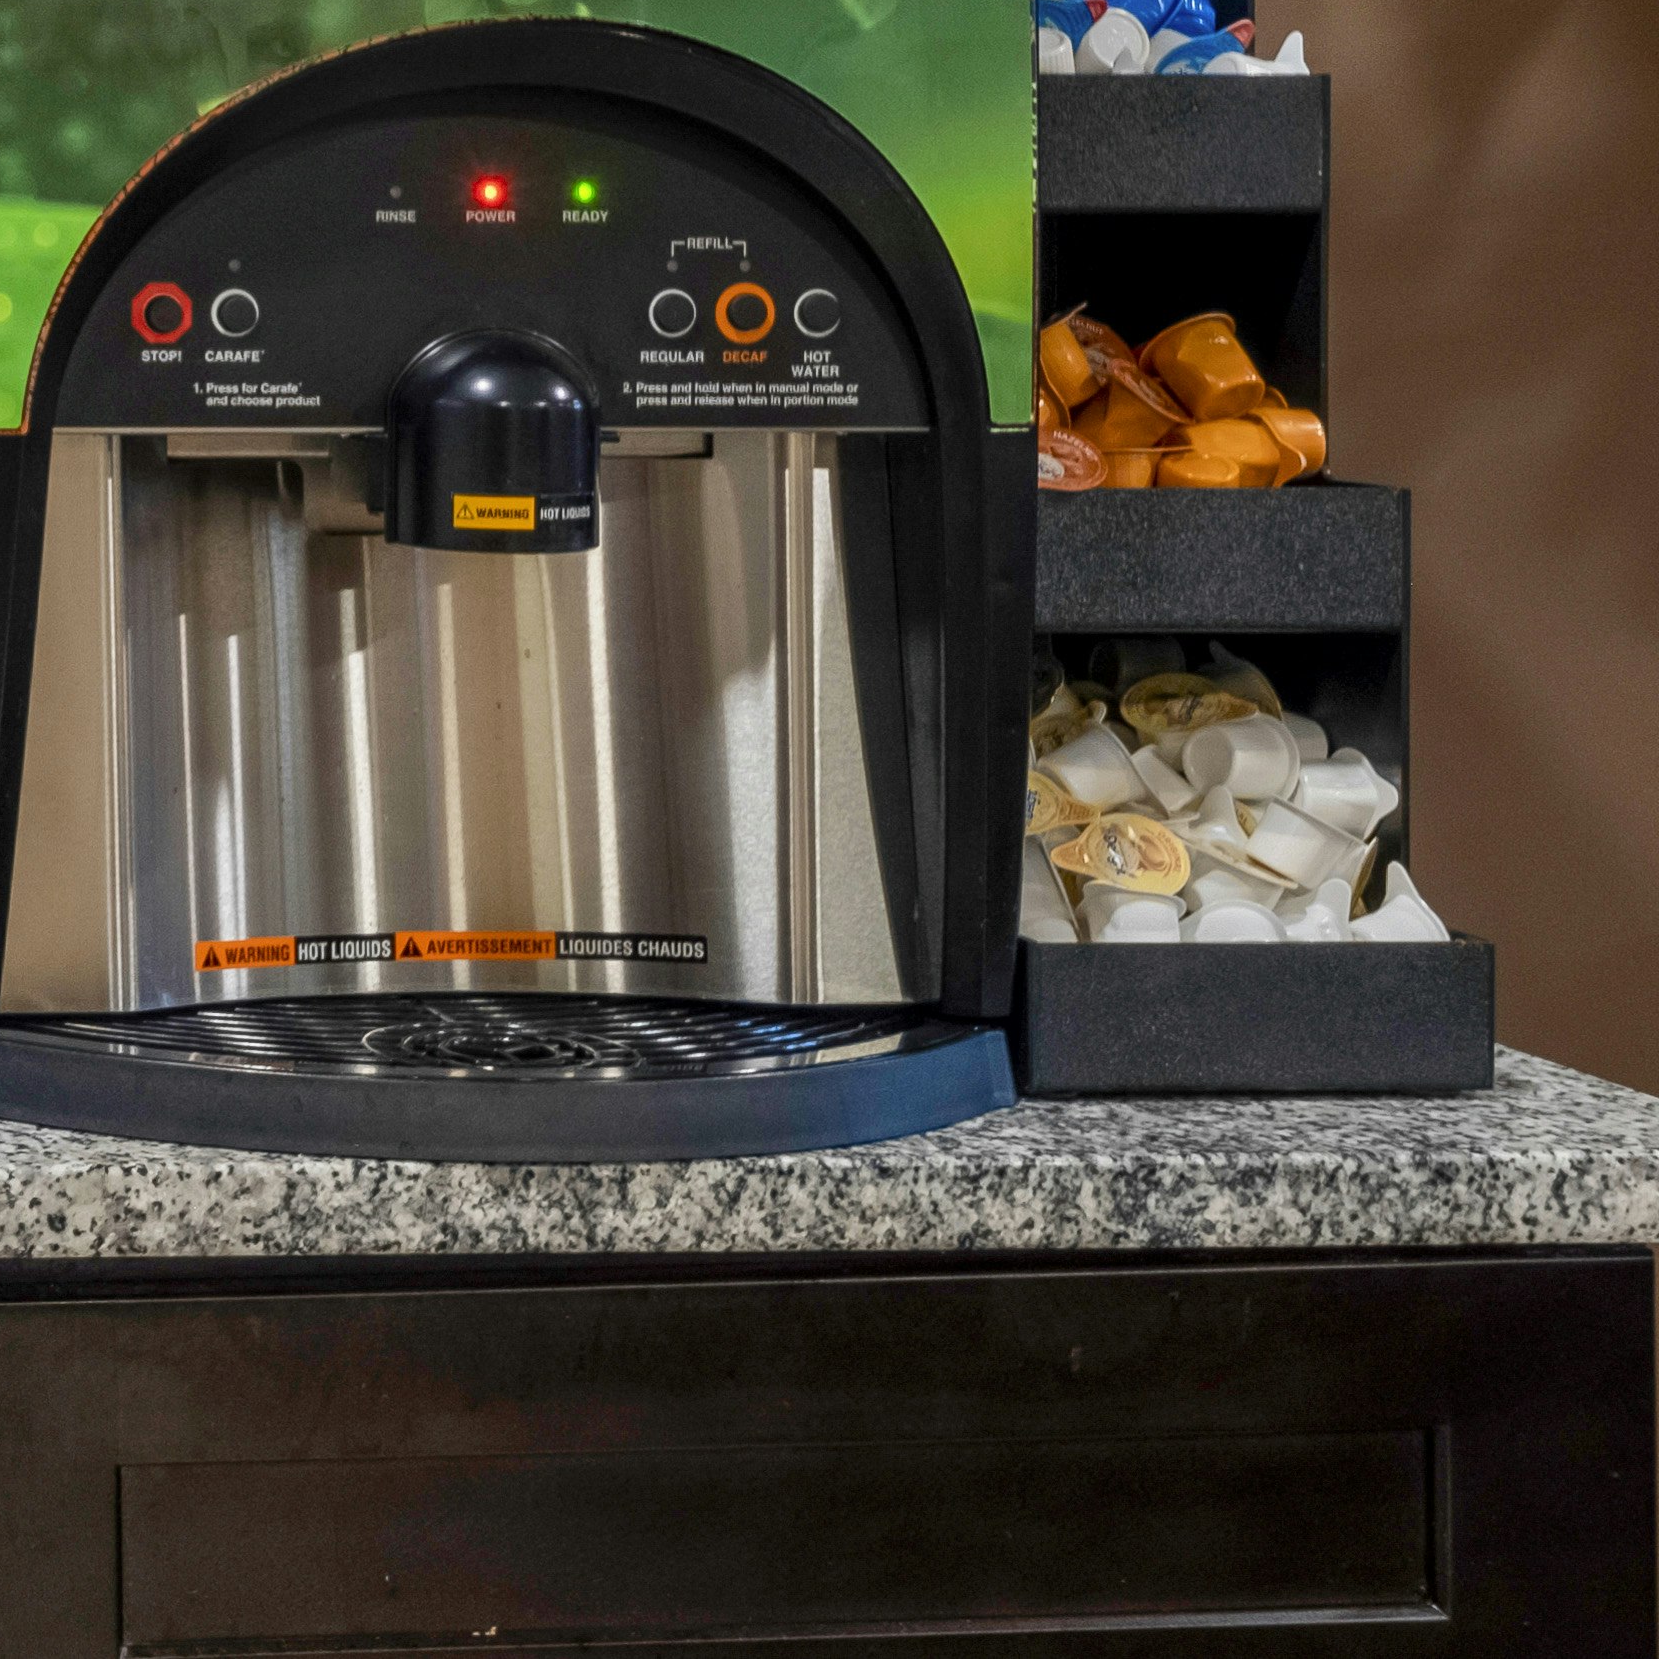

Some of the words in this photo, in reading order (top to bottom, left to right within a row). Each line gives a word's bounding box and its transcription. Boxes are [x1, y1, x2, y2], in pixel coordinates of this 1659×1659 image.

[375, 210, 416, 223] RINSE
[466, 210, 516, 223] POWER
[562, 210, 609, 223] READY
[687, 237, 733, 250] REFILL
[141, 350, 182, 362] STOP!
[640, 350, 705, 363] REGULAR
[722, 350, 768, 363] DECAF
[803, 350, 831, 363] HOT
[791, 364, 840, 378] WATER
[193, 382, 203, 394] 1.
[206, 382, 239, 394] Press
[241, 382, 258, 394] for
[636, 382, 668, 394] Press
[670, 382, 692, 394] and
[694, 382, 719, 394] hold
[722, 382, 753, 394] when
[755, 382, 766, 394] in
[769, 382, 810, 394] manual
[812, 382, 844, 394] mode
[846, 382, 858, 394] or
[206, 395, 228, 407] and
[230, 395, 273, 407] choose
[275, 395, 321, 409] product
[636, 395, 668, 408] press
[670, 395, 692, 406] and
[694, 395, 735, 406] release
[737, 395, 768, 406] when
[784, 395, 824, 408] portion
[826, 395, 858, 406] mode
[476, 507, 530, 520] WARNING
[540, 506, 560, 520] HOT
[225, 943, 291, 968] WARNING
[298, 942, 329, 961] HOT
[331, 939, 392, 960] LIQUIDS
[426, 937, 552, 956] AVERTISSEMENT
[559, 938, 633, 957] LIQUIDES
[638, 939, 705, 959] CHAUDS
